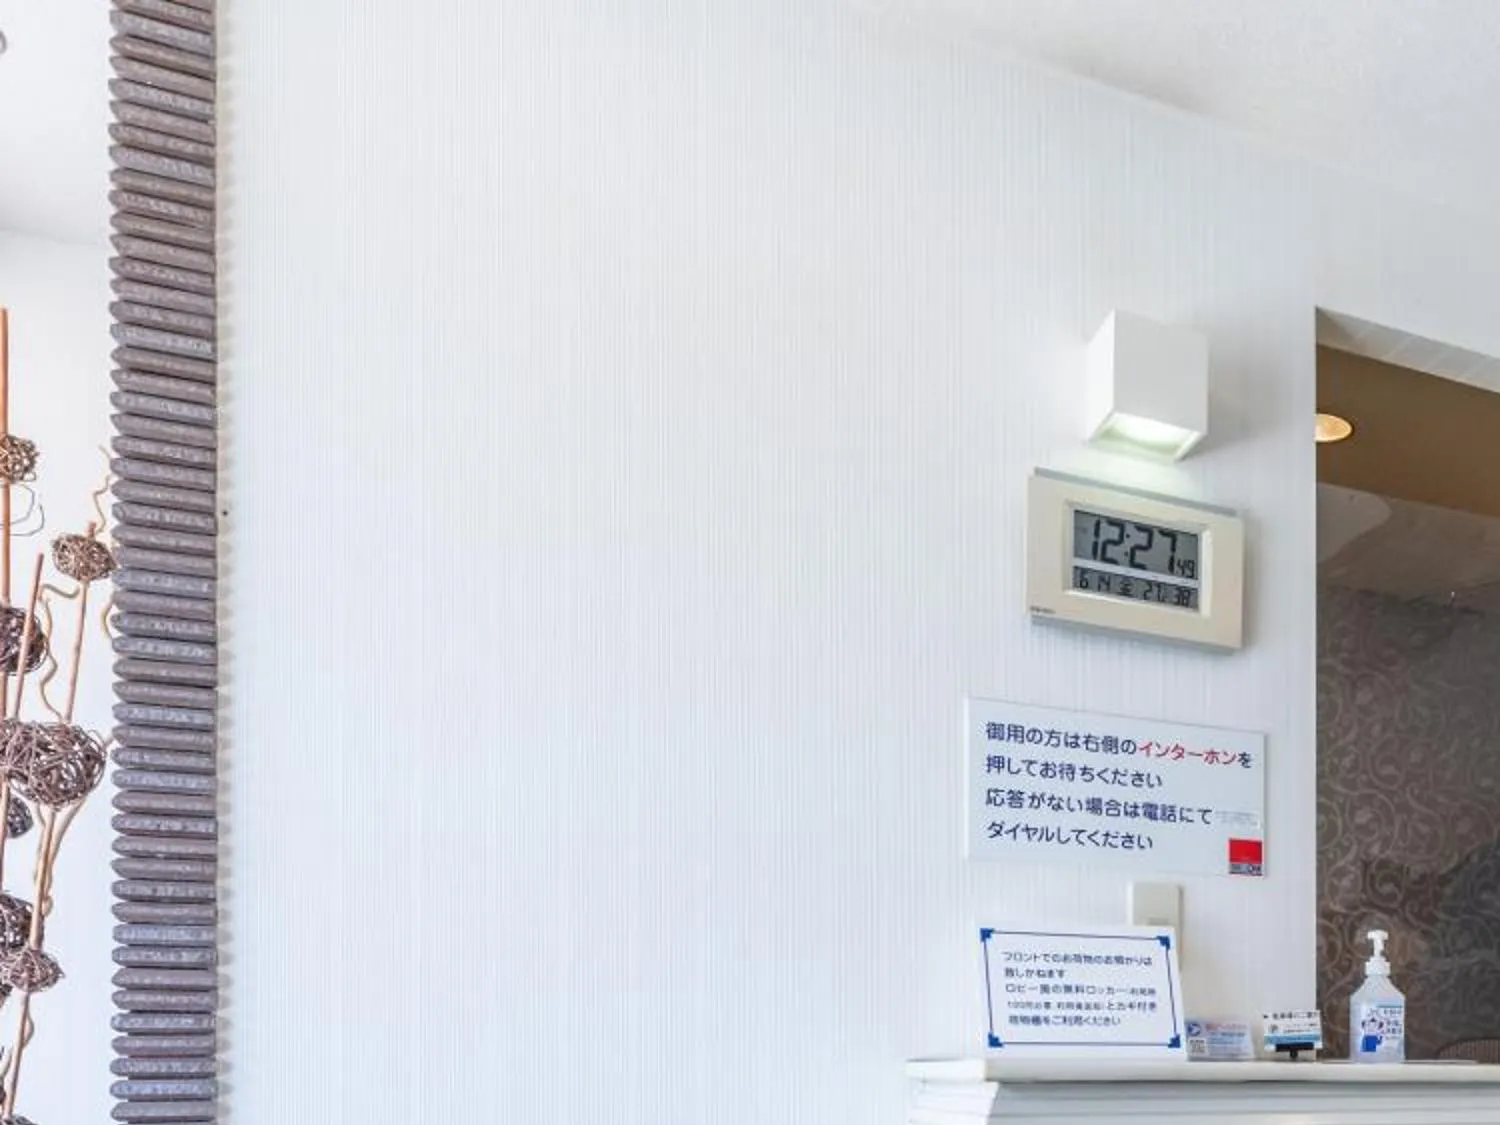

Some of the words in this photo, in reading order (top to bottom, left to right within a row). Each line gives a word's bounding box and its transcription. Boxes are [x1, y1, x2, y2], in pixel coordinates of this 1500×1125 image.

[1092, 516, 1177, 573] 12:27
[986, 721, 1253, 768] 御用の方は右側のインターホンを
[986, 754, 1163, 788] 押してお待ちください
[986, 788, 1213, 825] 応答がない場合は電話にて
[987, 820, 1153, 850] ダイヤルしてください
